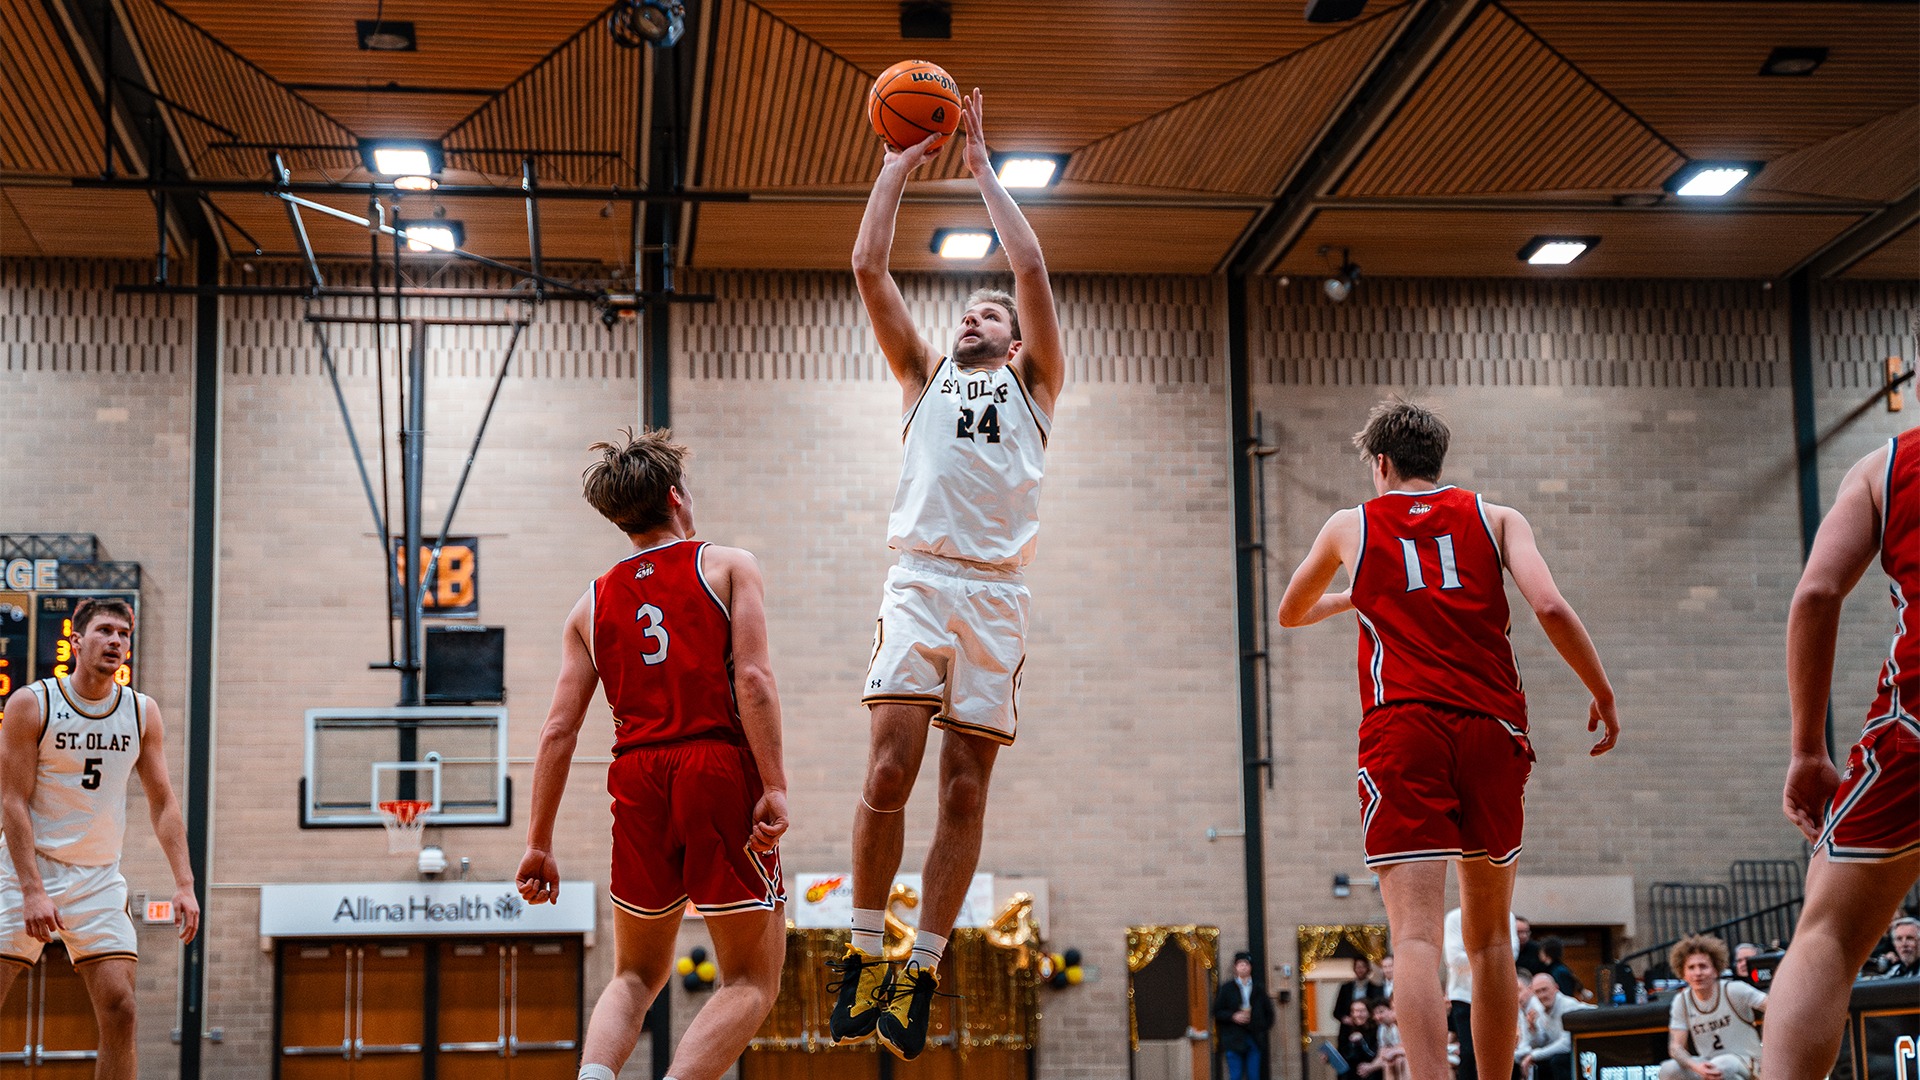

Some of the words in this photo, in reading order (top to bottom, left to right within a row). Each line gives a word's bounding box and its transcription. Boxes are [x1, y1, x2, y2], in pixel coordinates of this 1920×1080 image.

[957, 403, 1001, 444] 24
[0, 558, 59, 591] GE
[1394, 533, 1464, 592] 11
[635, 602, 670, 666] 3
[55, 732, 82, 750] ST.
[86, 733, 131, 752] OLAF
[81, 757, 103, 790] 5
[332, 895, 405, 923] Allina
[408, 894, 491, 922] Health
[1712, 1034, 1724, 1050] 2
